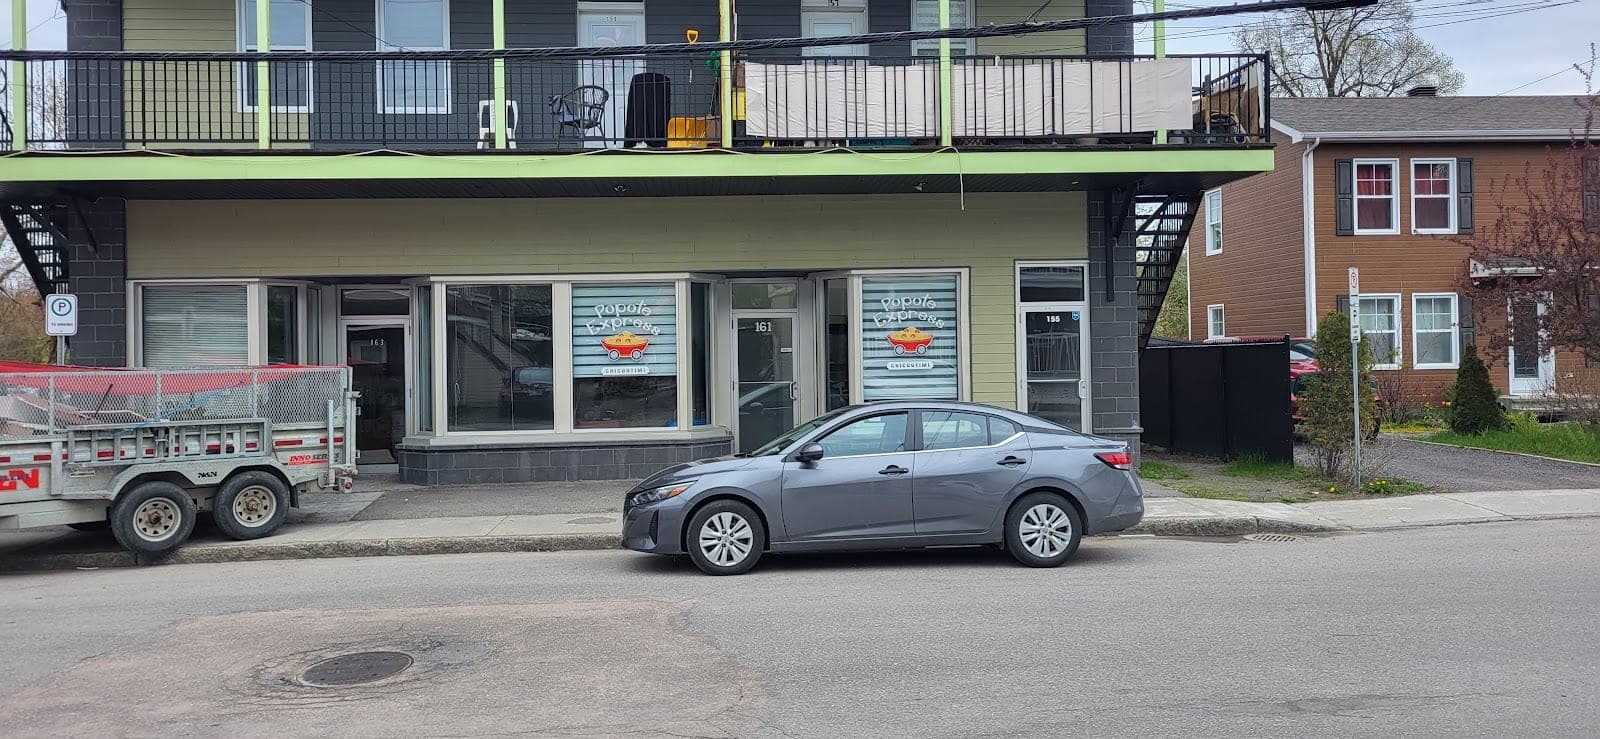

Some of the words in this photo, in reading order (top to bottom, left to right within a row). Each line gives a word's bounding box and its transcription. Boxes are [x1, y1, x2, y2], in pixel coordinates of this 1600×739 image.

[58, 302, 67, 312] P
[593, 300, 652, 319] Popote
[880, 293, 936, 312] Popote
[586, 317, 661, 336] Express
[755, 321, 772, 332] 161
[872, 310, 945, 329] Express
[1046, 315, 1061, 323] 155
[289, 454, 311, 462] INNO
